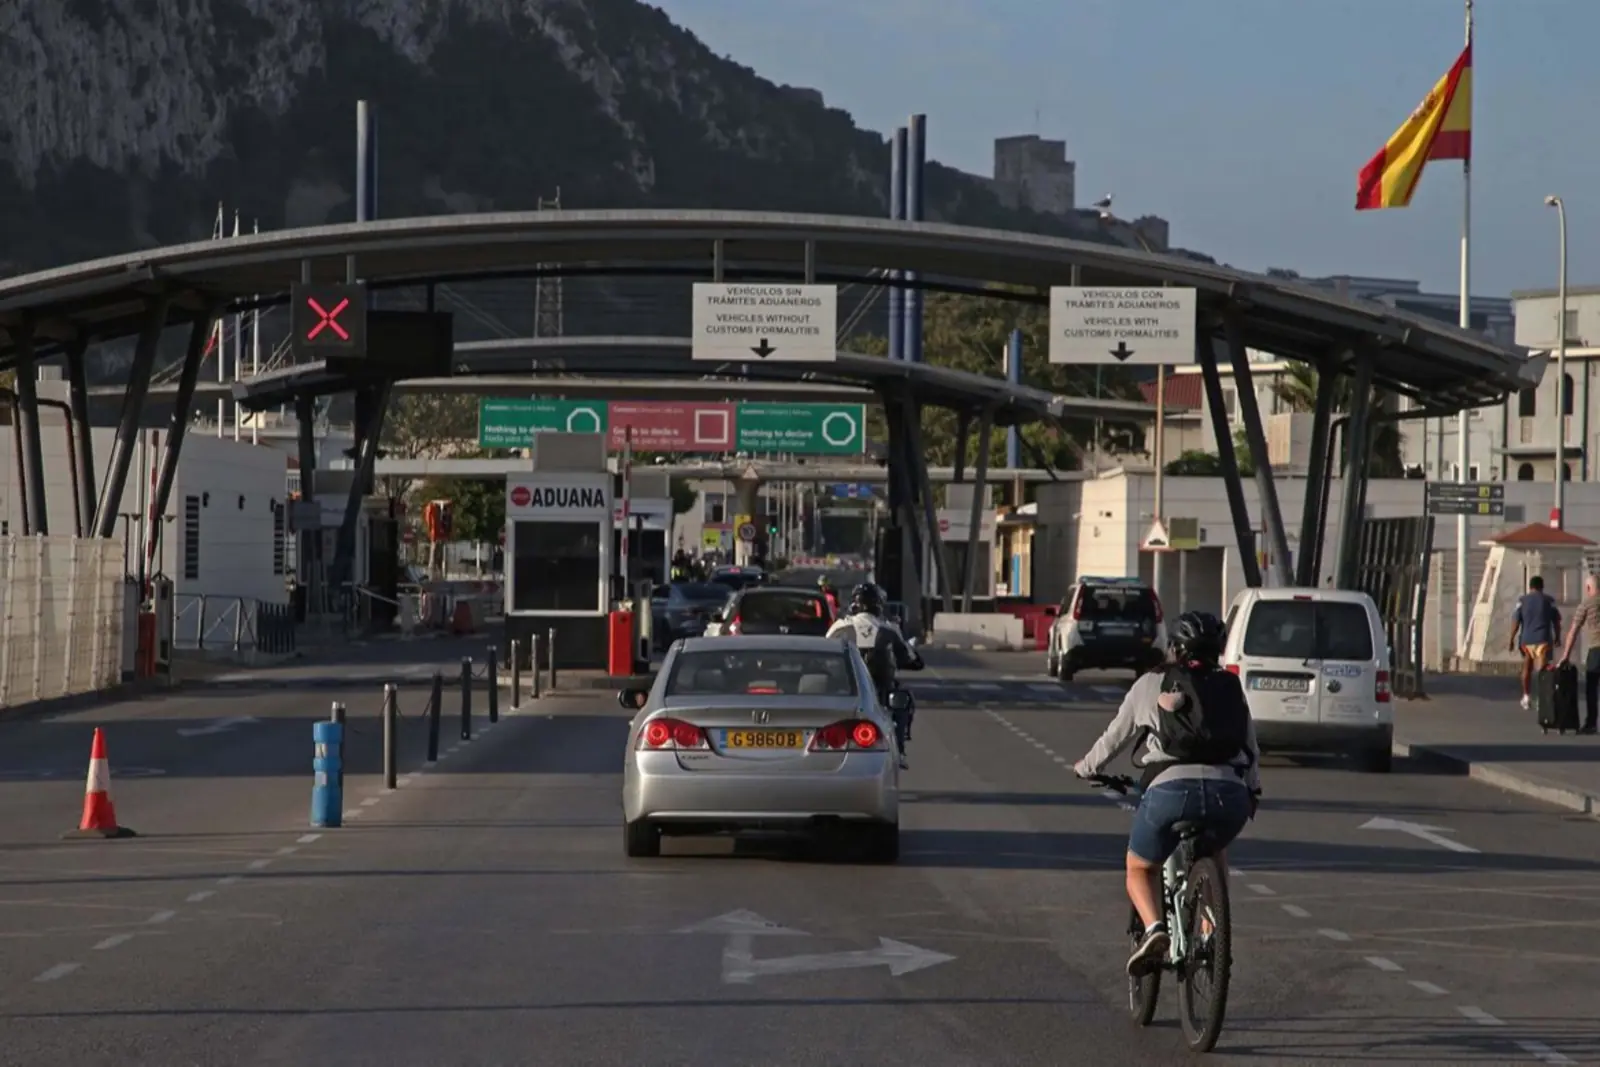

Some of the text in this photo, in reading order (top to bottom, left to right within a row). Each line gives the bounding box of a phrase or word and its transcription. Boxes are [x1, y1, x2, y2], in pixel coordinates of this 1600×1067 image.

[786, 287, 802, 296] SIN
[1141, 290, 1164, 299] CON
[759, 297, 821, 307] ADUANEROS
[1117, 300, 1180, 310] ADUANEROS
[716, 314, 811, 323] VEHICLES WITHOUT
[1083, 317, 1159, 326] VEHICLES WITH
[706, 325, 820, 335] CUSTOMS FORMALITIES
[1064, 329, 1179, 338] CUSTOMS FORMALITIES
[531, 488, 605, 508] ADUANA
[733, 732, 742, 746] G
